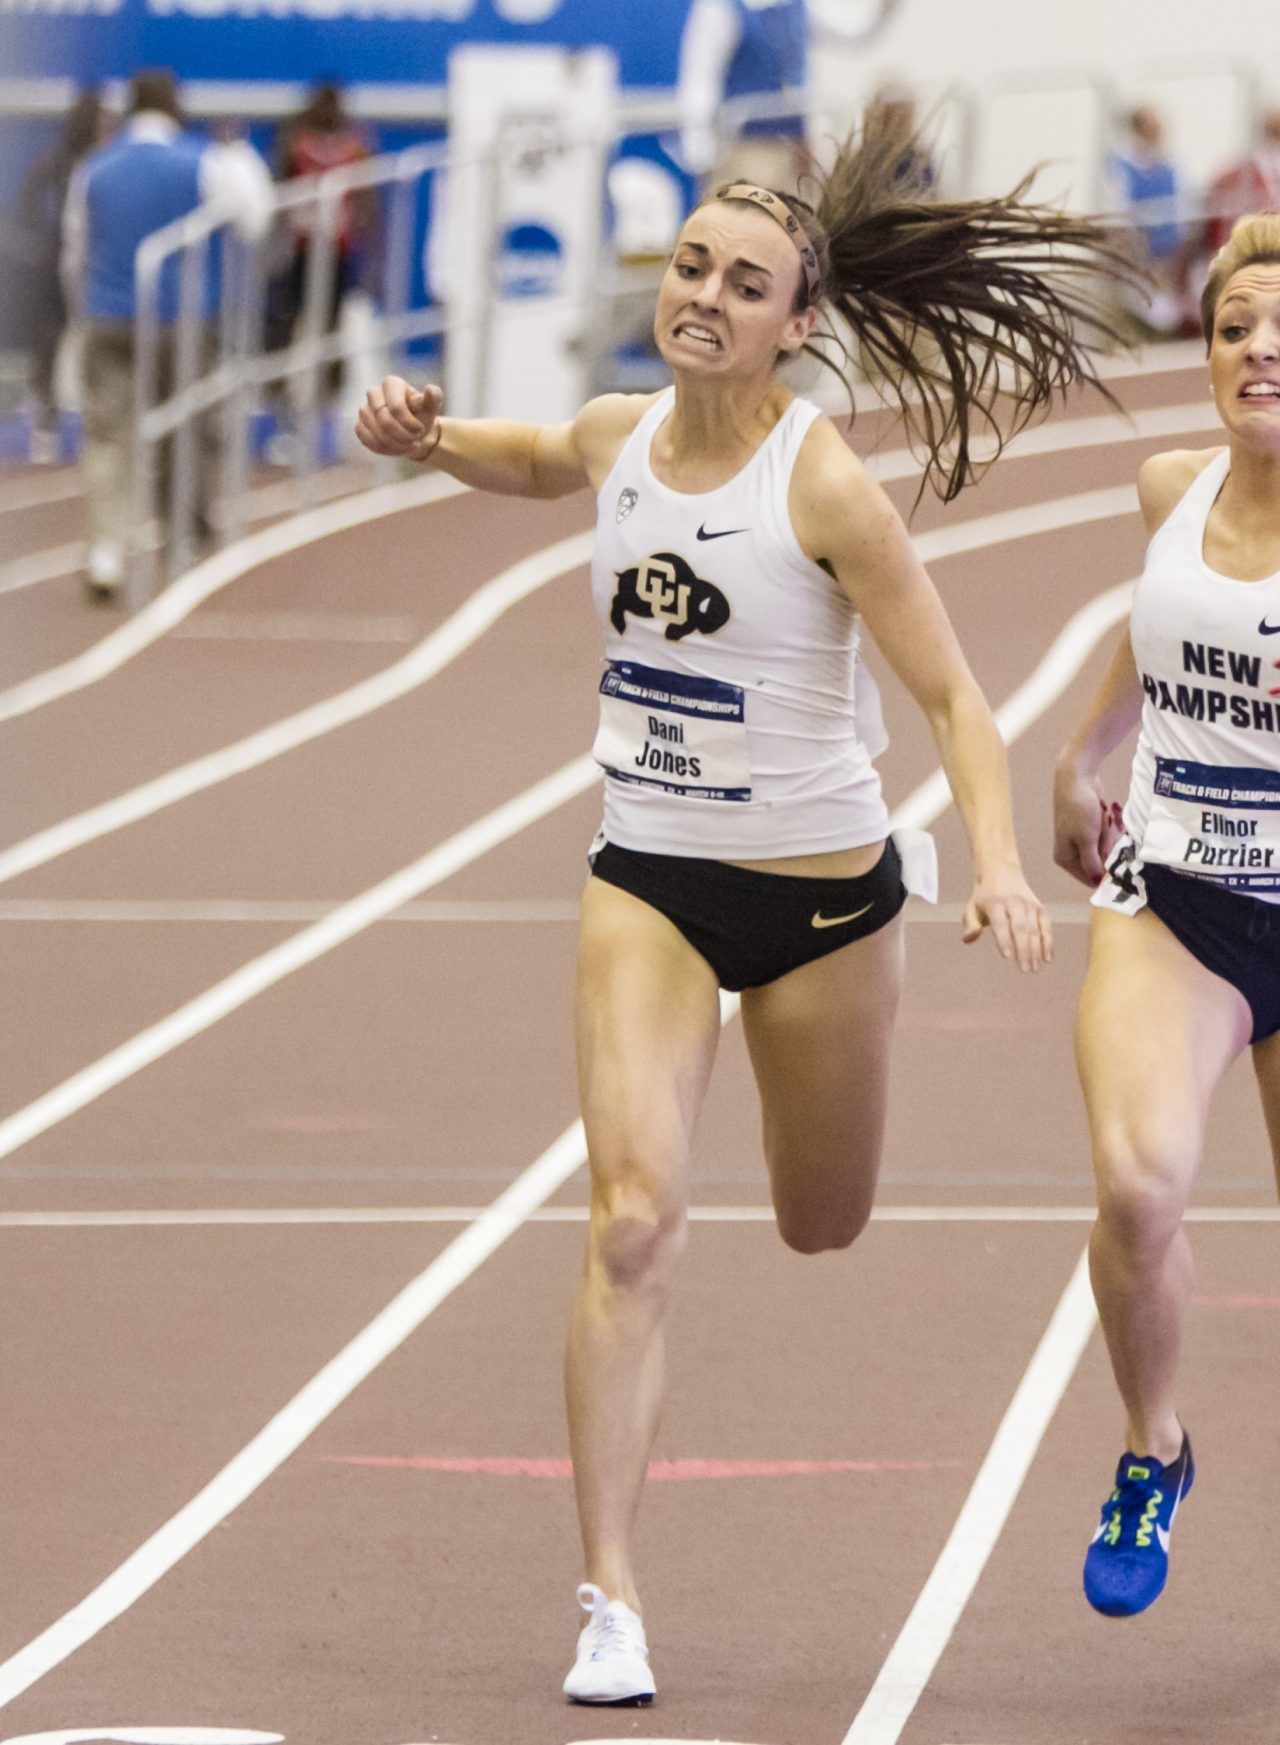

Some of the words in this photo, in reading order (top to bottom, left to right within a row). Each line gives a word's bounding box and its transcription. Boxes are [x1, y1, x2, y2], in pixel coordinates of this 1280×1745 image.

[1182, 640, 1262, 688] NEW
[648, 688, 670, 704] FIELD
[670, 694, 741, 715] CHAMPIONSHIPS
[648, 715, 684, 744] Dani
[635, 740, 702, 777] Jones
[1172, 781, 1197, 796] TRACK
[1205, 786, 1230, 800] FIELD
[1201, 811, 1259, 837] Elinor
[1183, 837, 1275, 868] Purrier
